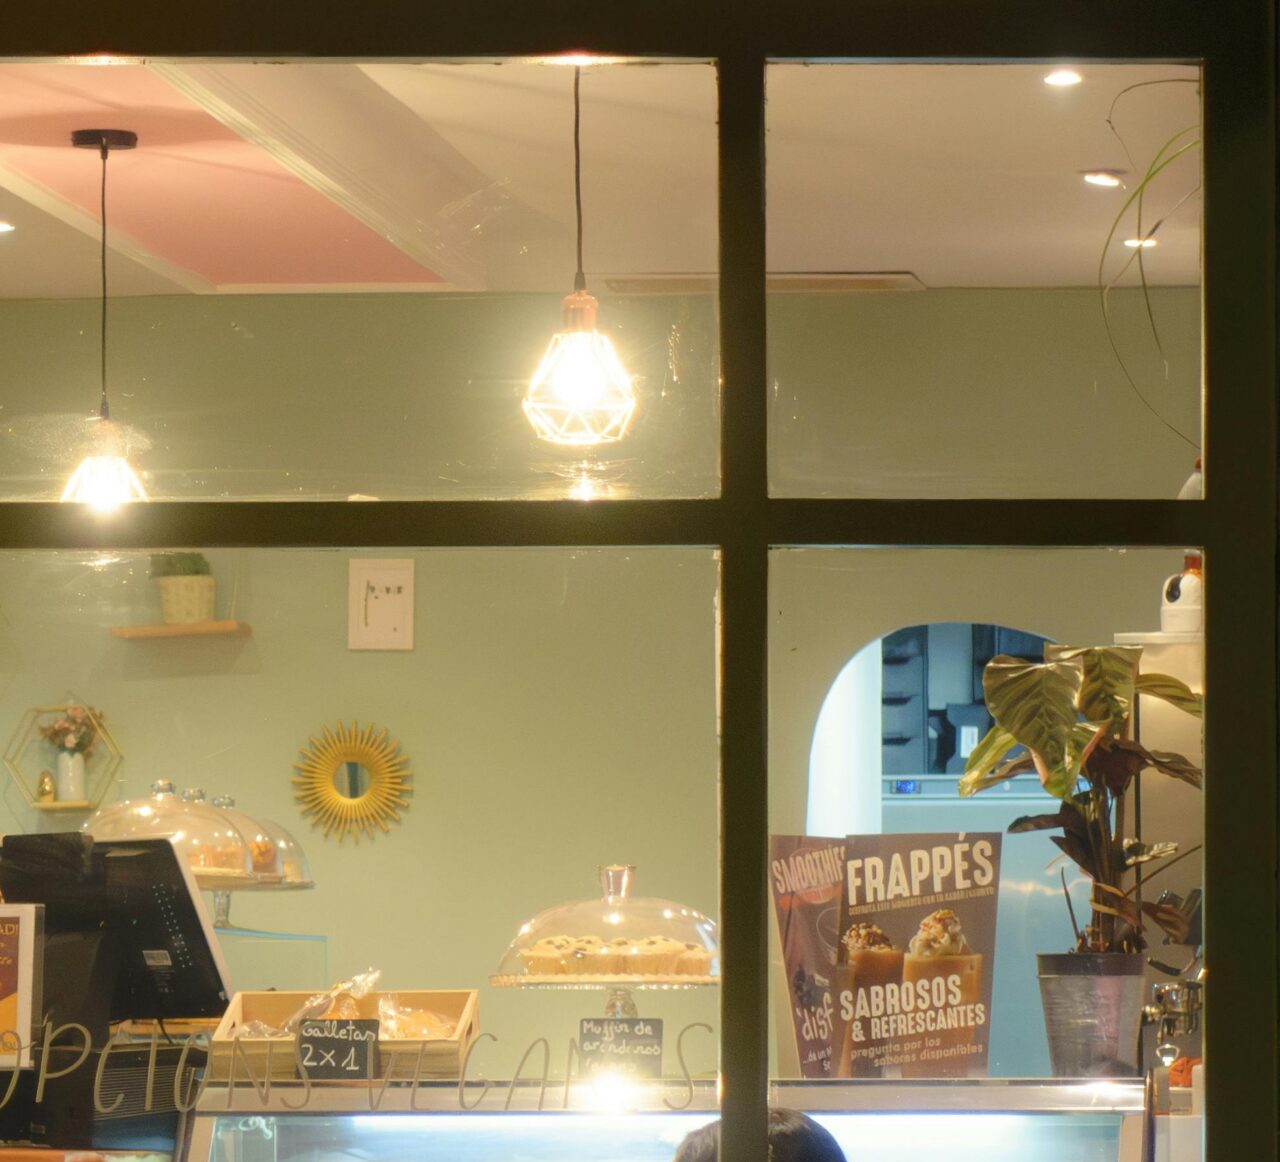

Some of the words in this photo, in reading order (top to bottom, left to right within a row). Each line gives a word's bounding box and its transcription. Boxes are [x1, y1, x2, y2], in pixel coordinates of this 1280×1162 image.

[846, 832, 993, 905] FRAPPÉS
[839, 974, 962, 1021] SABROSOS
[634, 1020, 654, 1036] de
[851, 1020, 866, 1042] &
[870, 1002, 986, 1041] REFRESCANTES
[850, 1042, 901, 1061] pregunta
[904, 1039, 923, 1053] por
[925, 1037, 942, 1049] los
[873, 1052, 917, 1067] sabores
[919, 1043, 984, 1061] disponibles
